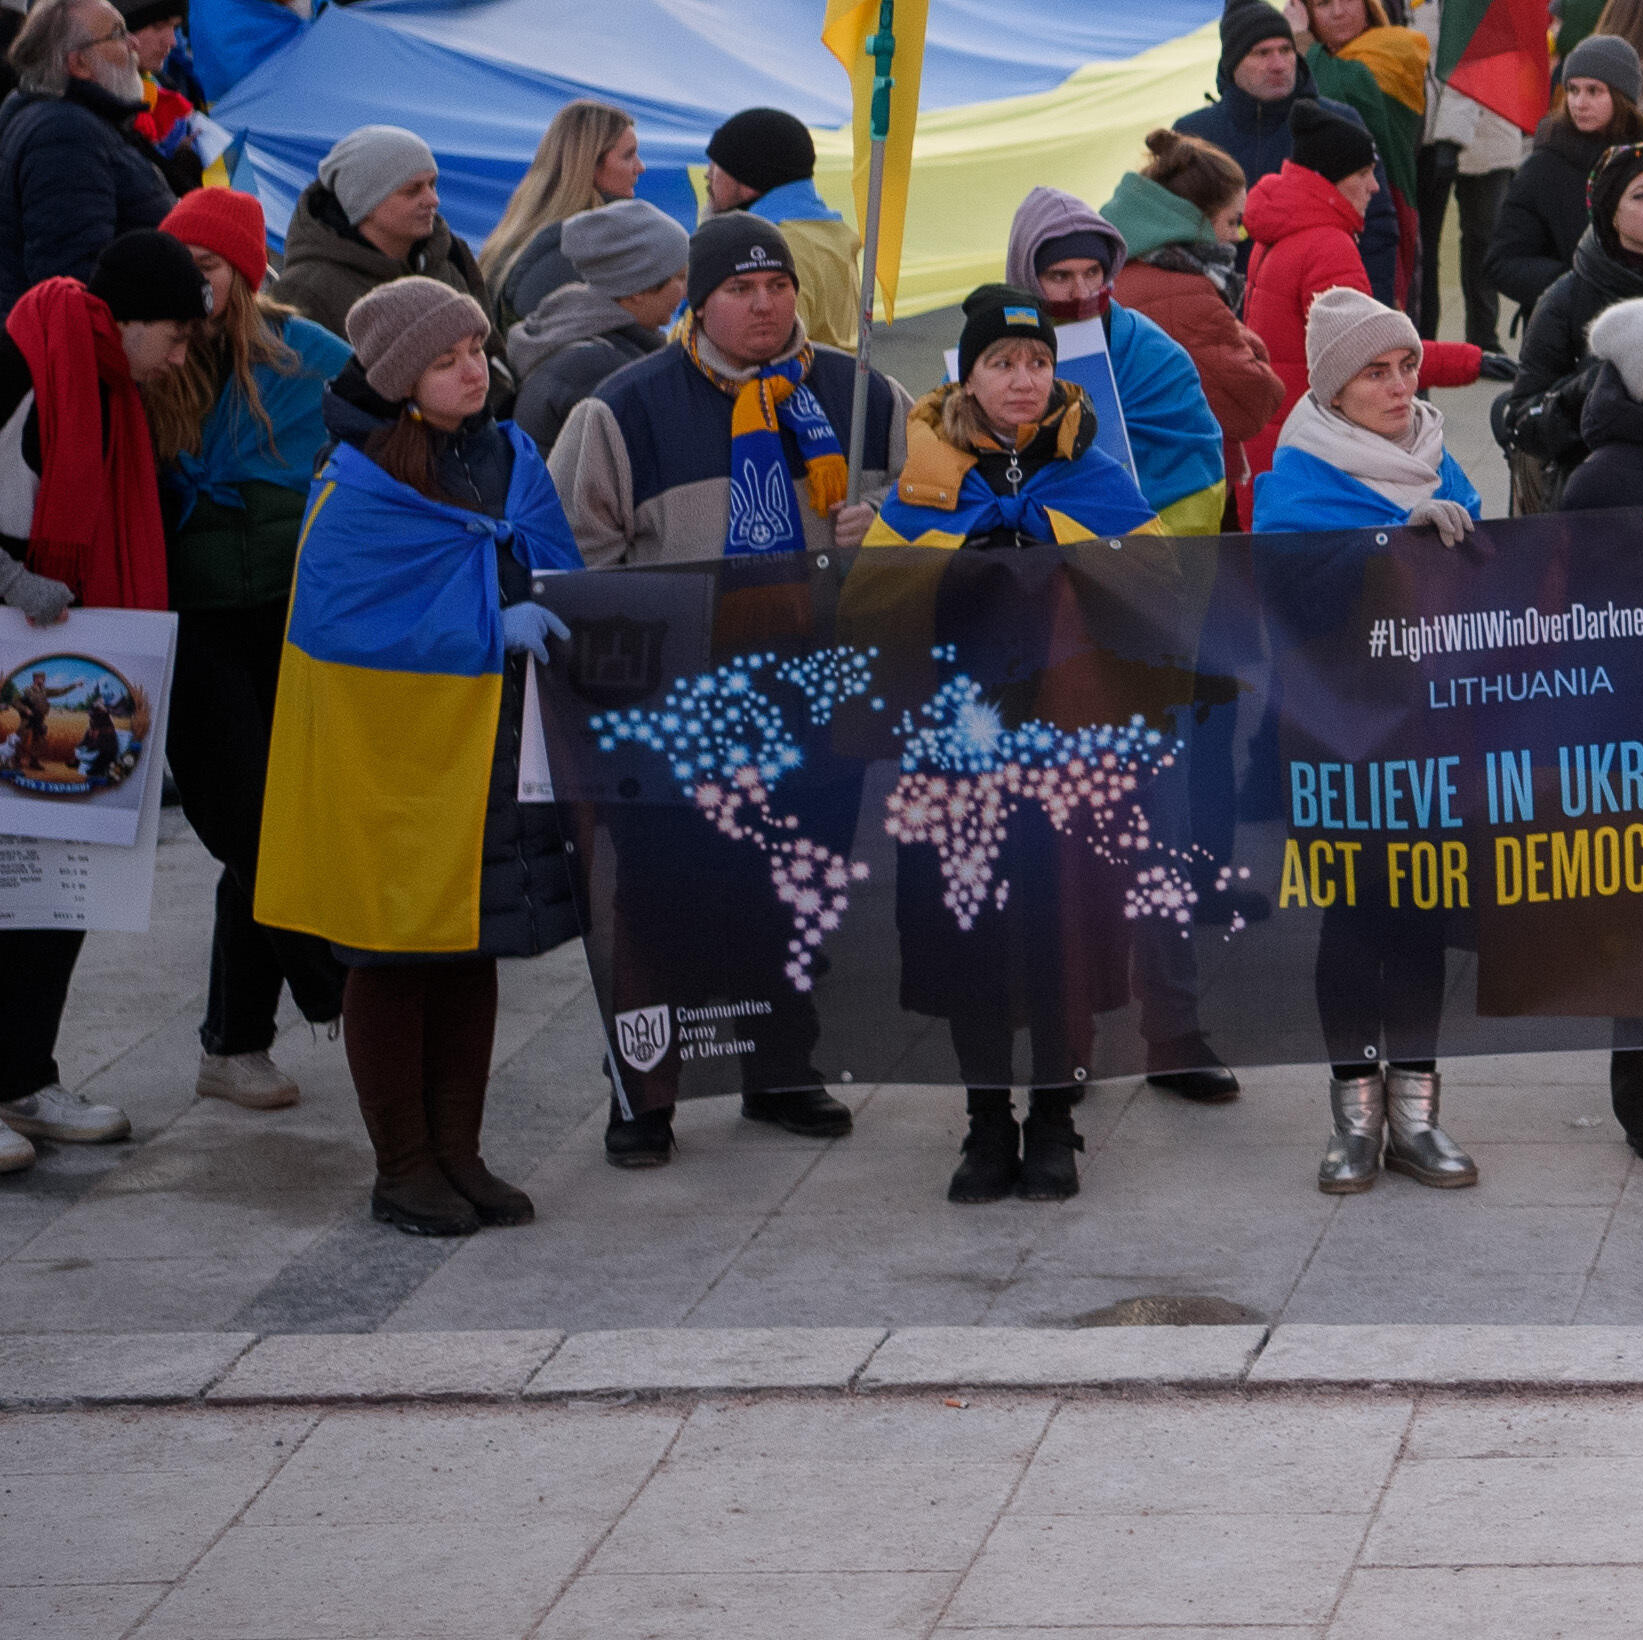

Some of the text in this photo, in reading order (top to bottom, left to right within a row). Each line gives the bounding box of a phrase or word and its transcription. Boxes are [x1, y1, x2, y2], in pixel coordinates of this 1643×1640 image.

[1429, 666, 1614, 709] LITHUANIA
[1290, 756, 1463, 830] BELIEVE
[1486, 749, 1535, 825] IN
[1279, 838, 1362, 908] ACT
[1387, 839, 1470, 910] FOR
[676, 999, 772, 1023] Communities
[678, 1024, 716, 1042] Army
[680, 1038, 756, 1061] of Ukraine
